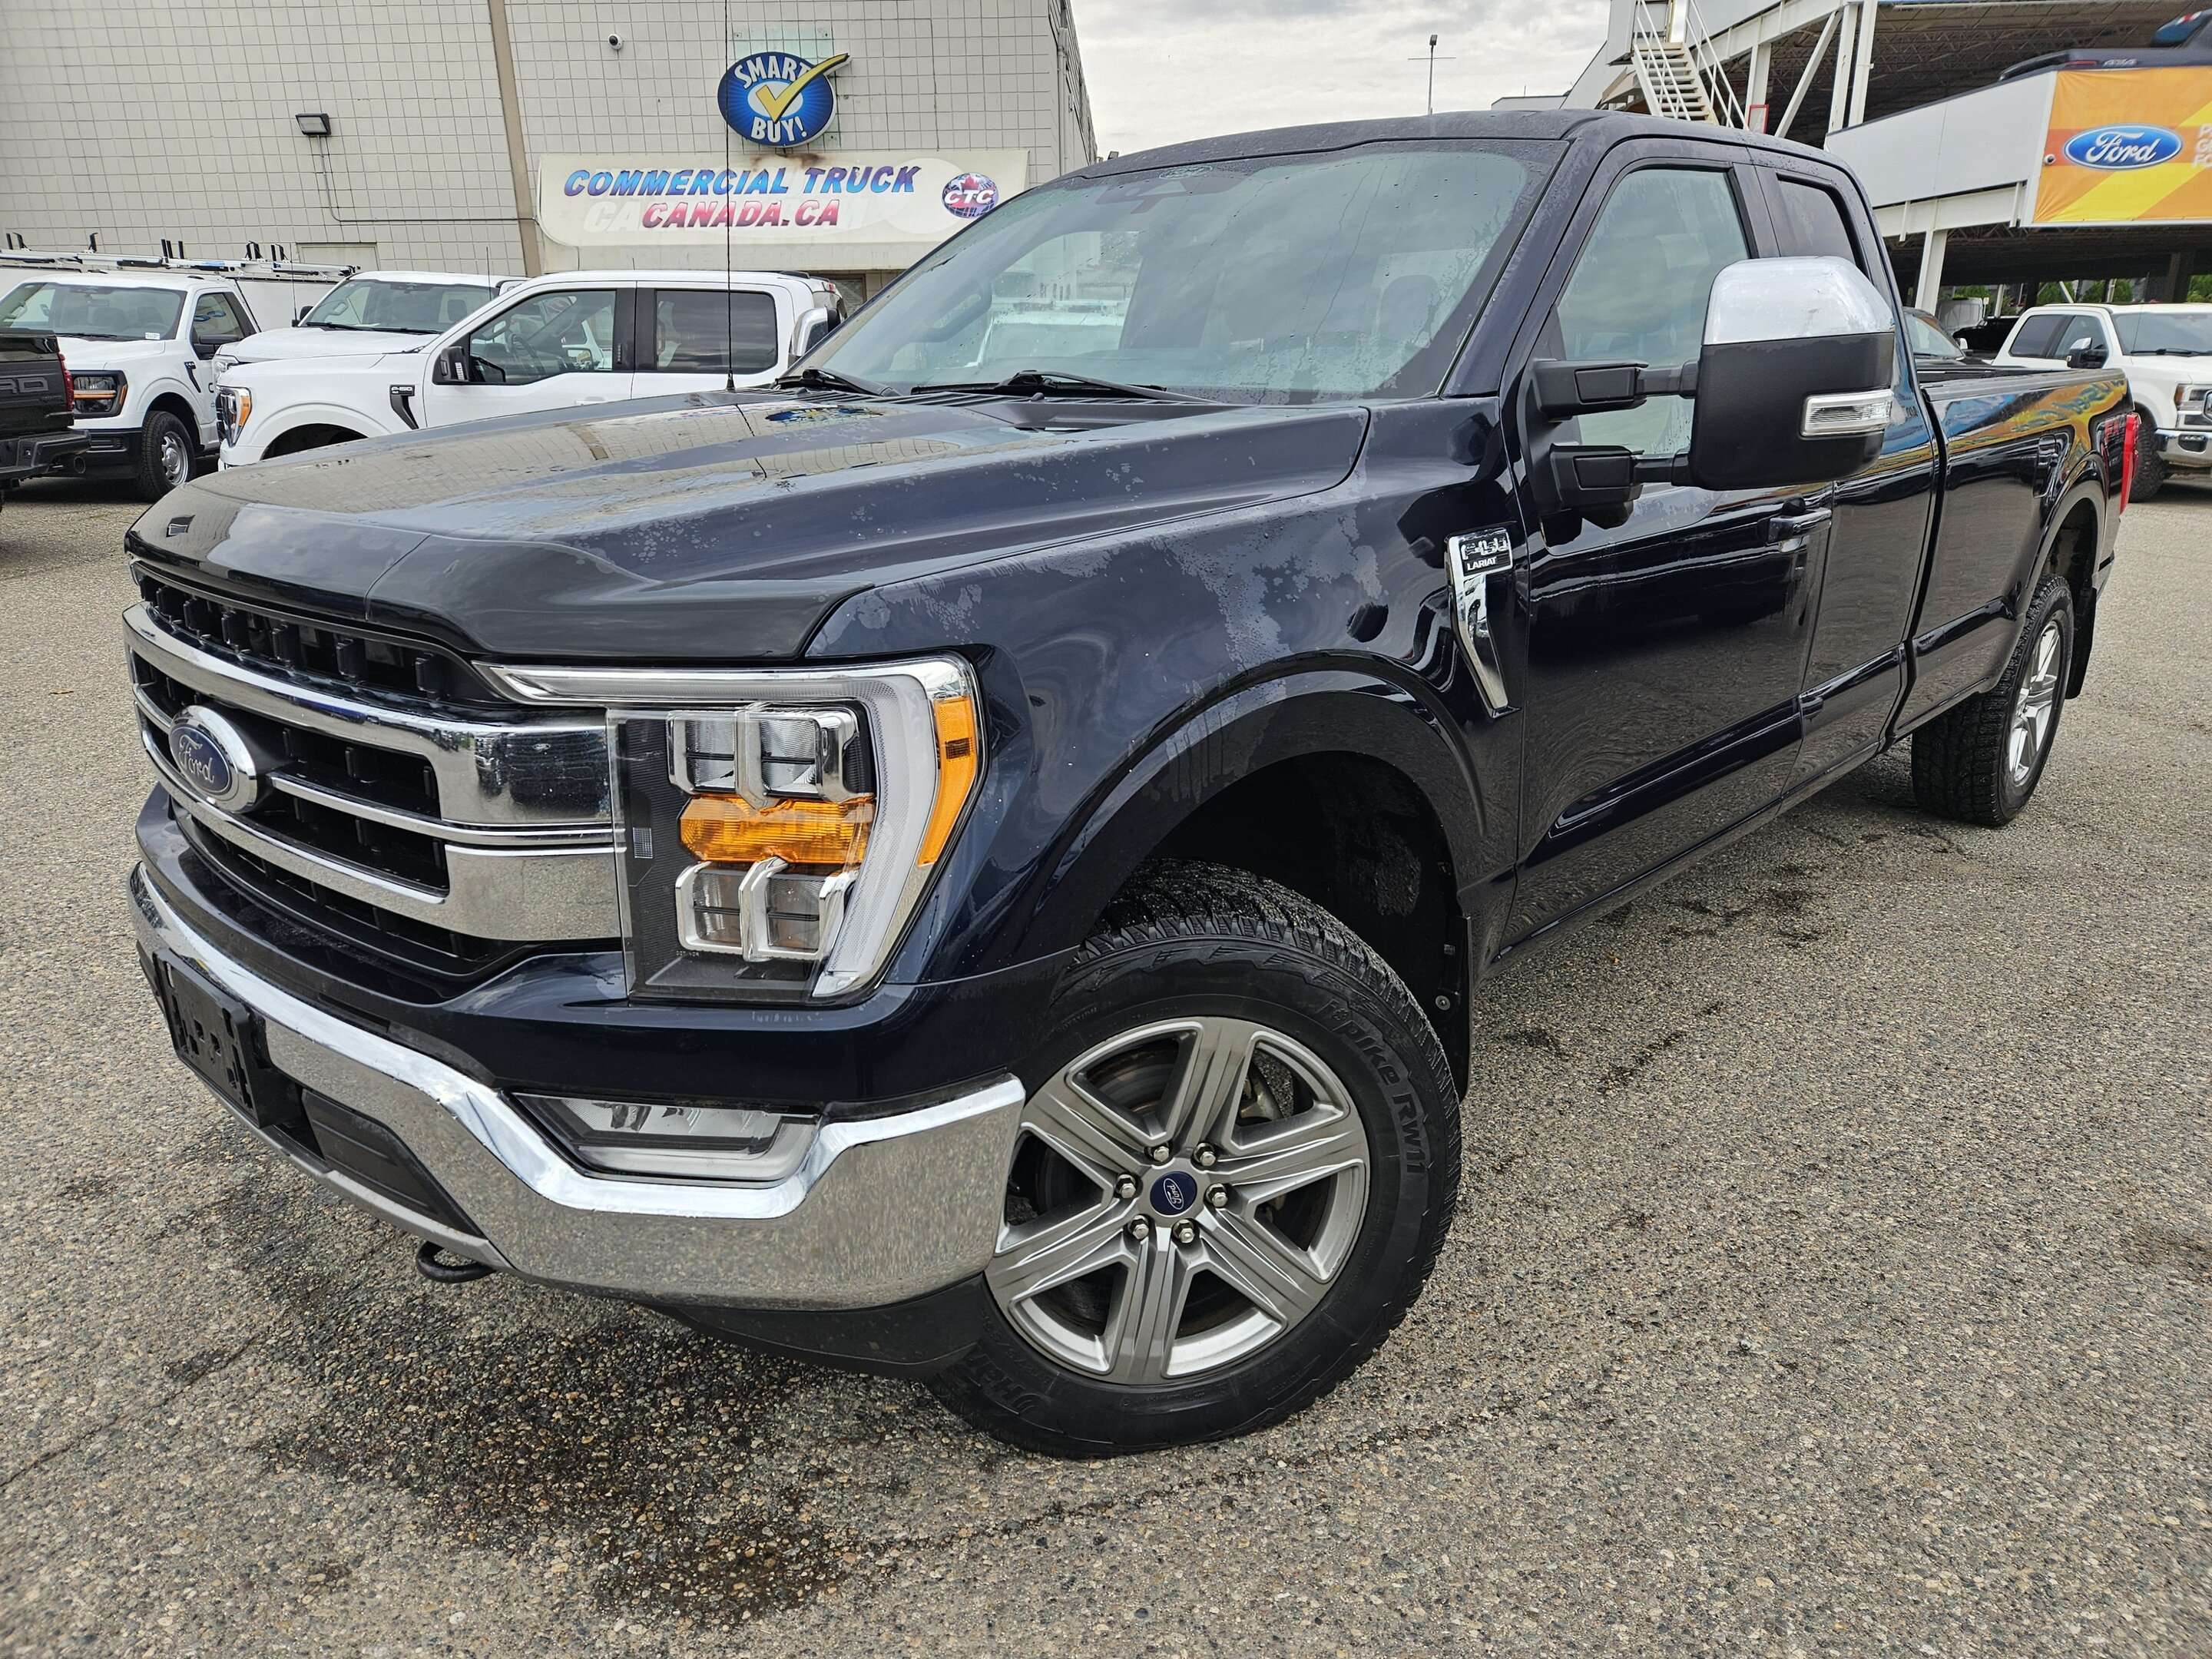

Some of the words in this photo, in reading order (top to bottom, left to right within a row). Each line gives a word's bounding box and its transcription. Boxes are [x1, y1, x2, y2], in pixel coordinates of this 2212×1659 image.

[734, 55, 812, 89] SMART
[750, 116, 807, 143] BUY!
[2085, 131, 2161, 163] Ford
[564, 168, 789, 197] COMMERCIAL
[803, 166, 922, 194] TRUCK
[944, 189, 994, 204] CTC
[642, 200, 840, 228] CANADA.CA
[1466, 556, 1498, 571] LARIAT
[179, 734, 215, 783] Ford
[1167, 1184, 1182, 1204] Ford
